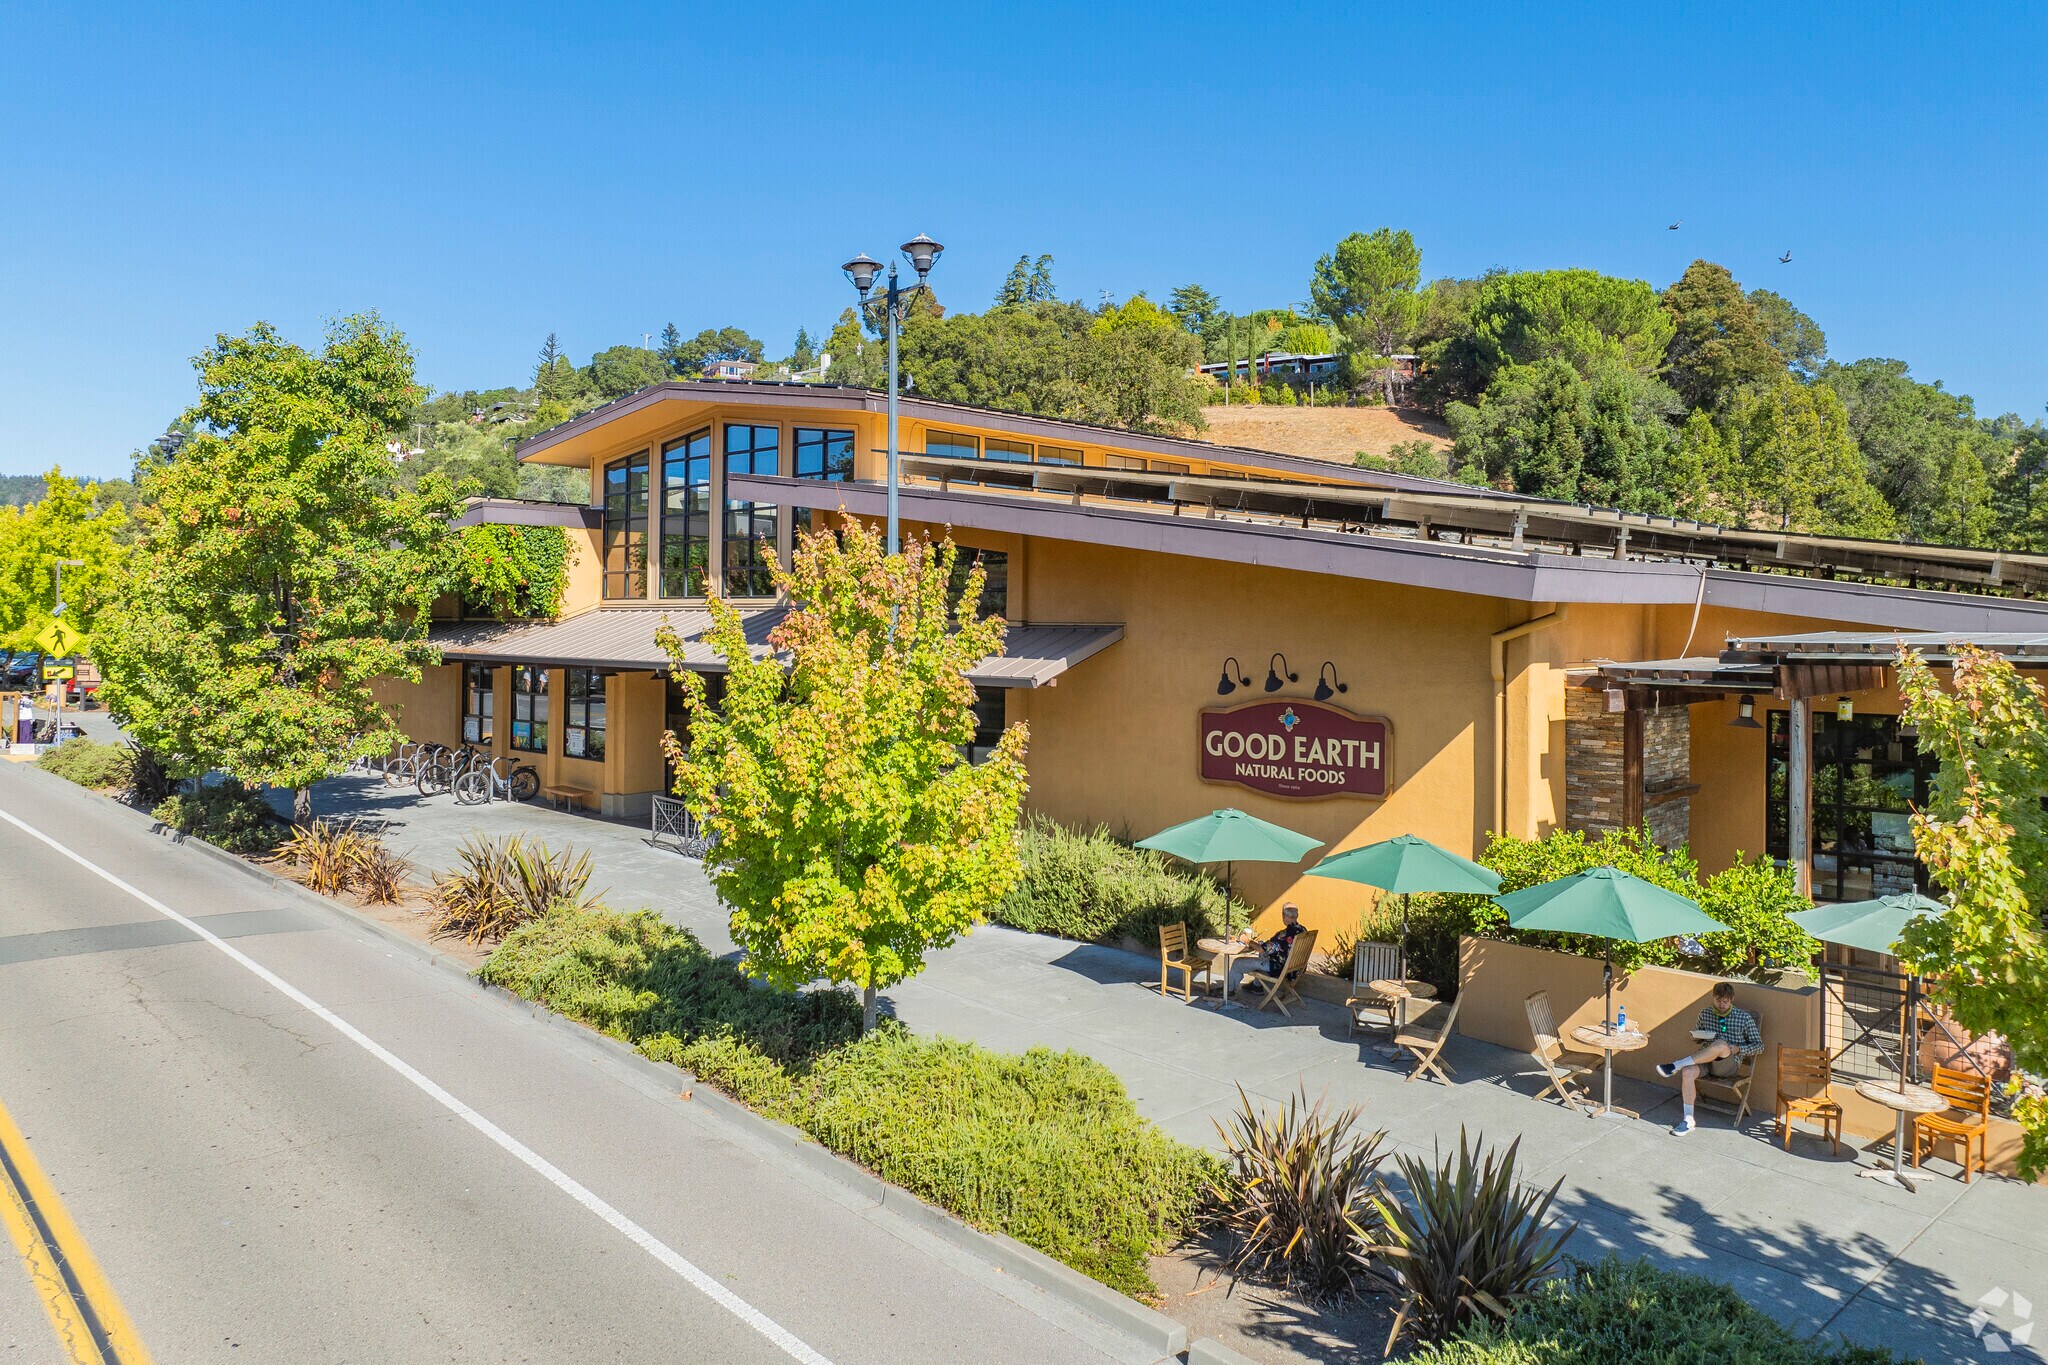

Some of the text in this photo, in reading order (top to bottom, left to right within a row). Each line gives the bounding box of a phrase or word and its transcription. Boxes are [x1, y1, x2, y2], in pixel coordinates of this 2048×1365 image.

[1206, 730, 1380, 769] GOOD EARTH
[1235, 763, 1345, 784] NATURAL FOODS
